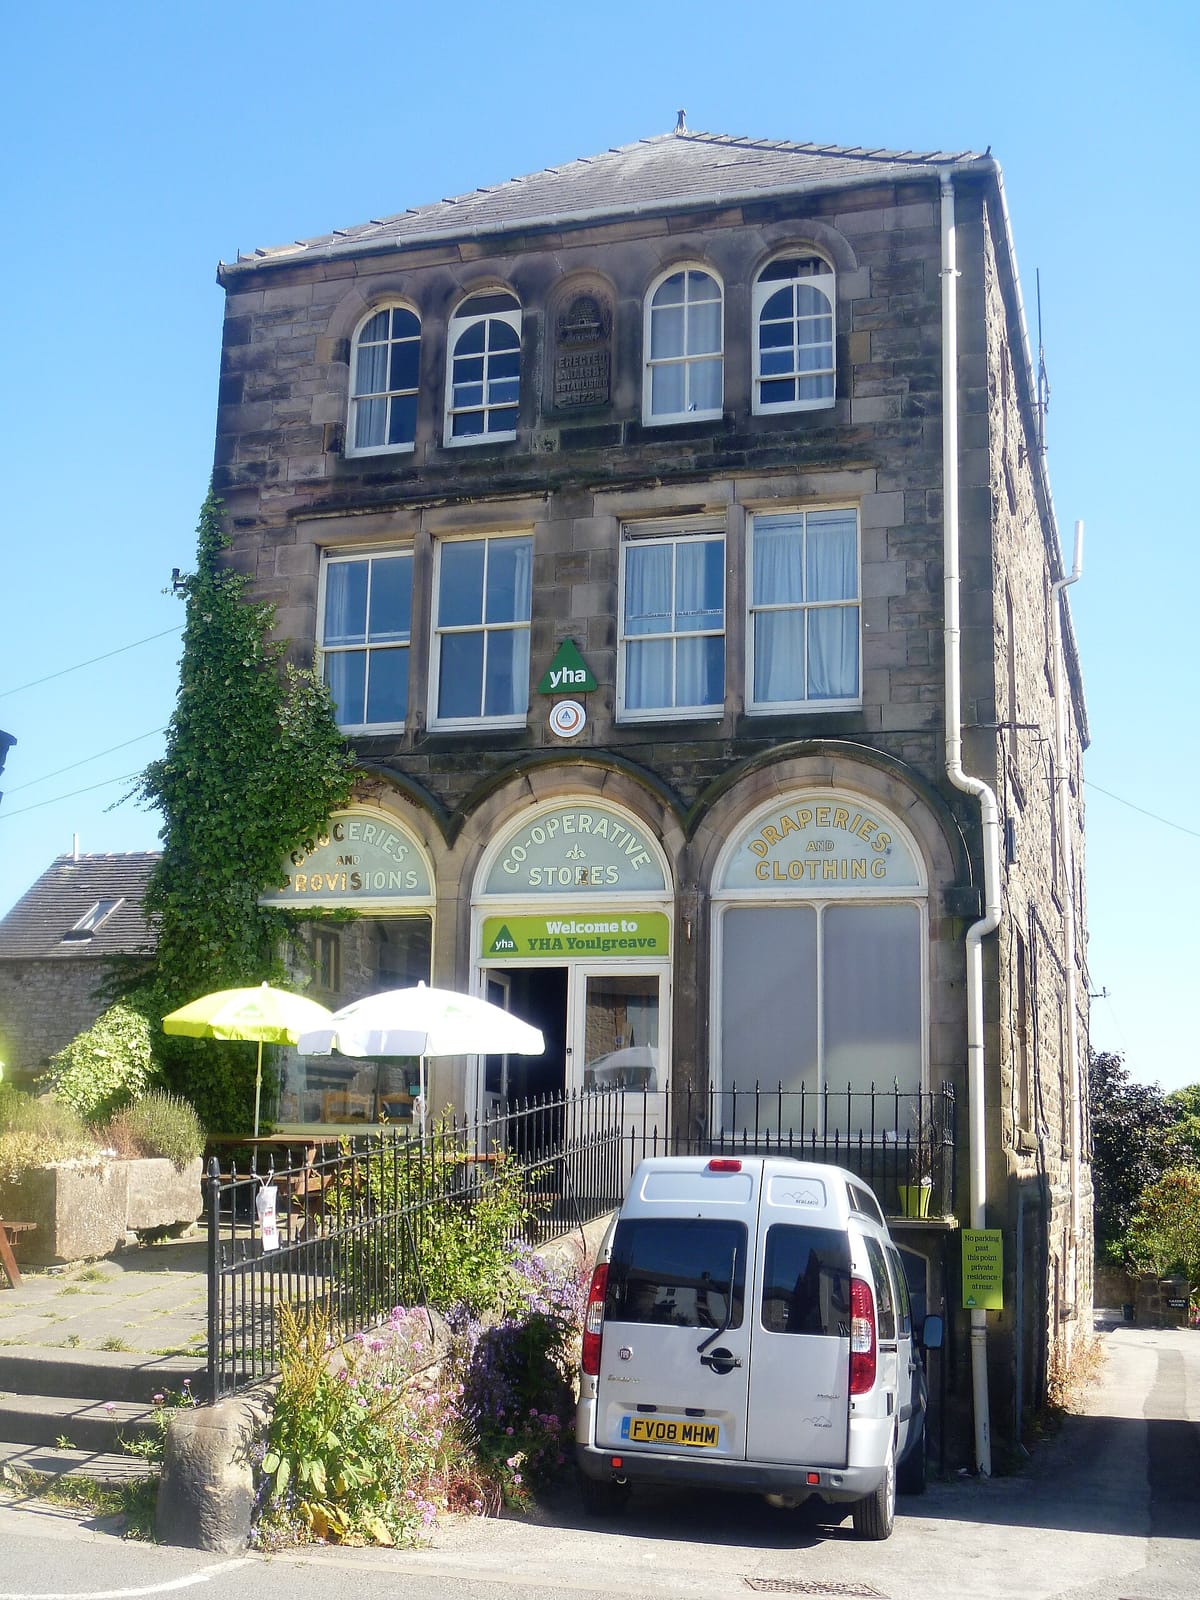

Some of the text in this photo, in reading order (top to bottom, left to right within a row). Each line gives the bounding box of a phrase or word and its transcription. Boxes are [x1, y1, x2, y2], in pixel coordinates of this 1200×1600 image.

[549, 666, 586, 689] yha
[748, 807, 892, 858] DRAPERIES
[502, 814, 652, 875] CO-OPERATIVE
[806, 840, 835, 852] AND
[336, 855, 361, 866] AND
[528, 865, 620, 887] STORES
[755, 858, 887, 880] CLOTHING
[546, 919, 638, 935] Welcome to
[495, 937, 514, 950] yha
[527, 936, 657, 952] YHA Youlgreave
[974, 1235, 1000, 1243] parking
[979, 1254, 997, 1262] point
[633, 1420, 716, 1444] FV08 MHM
